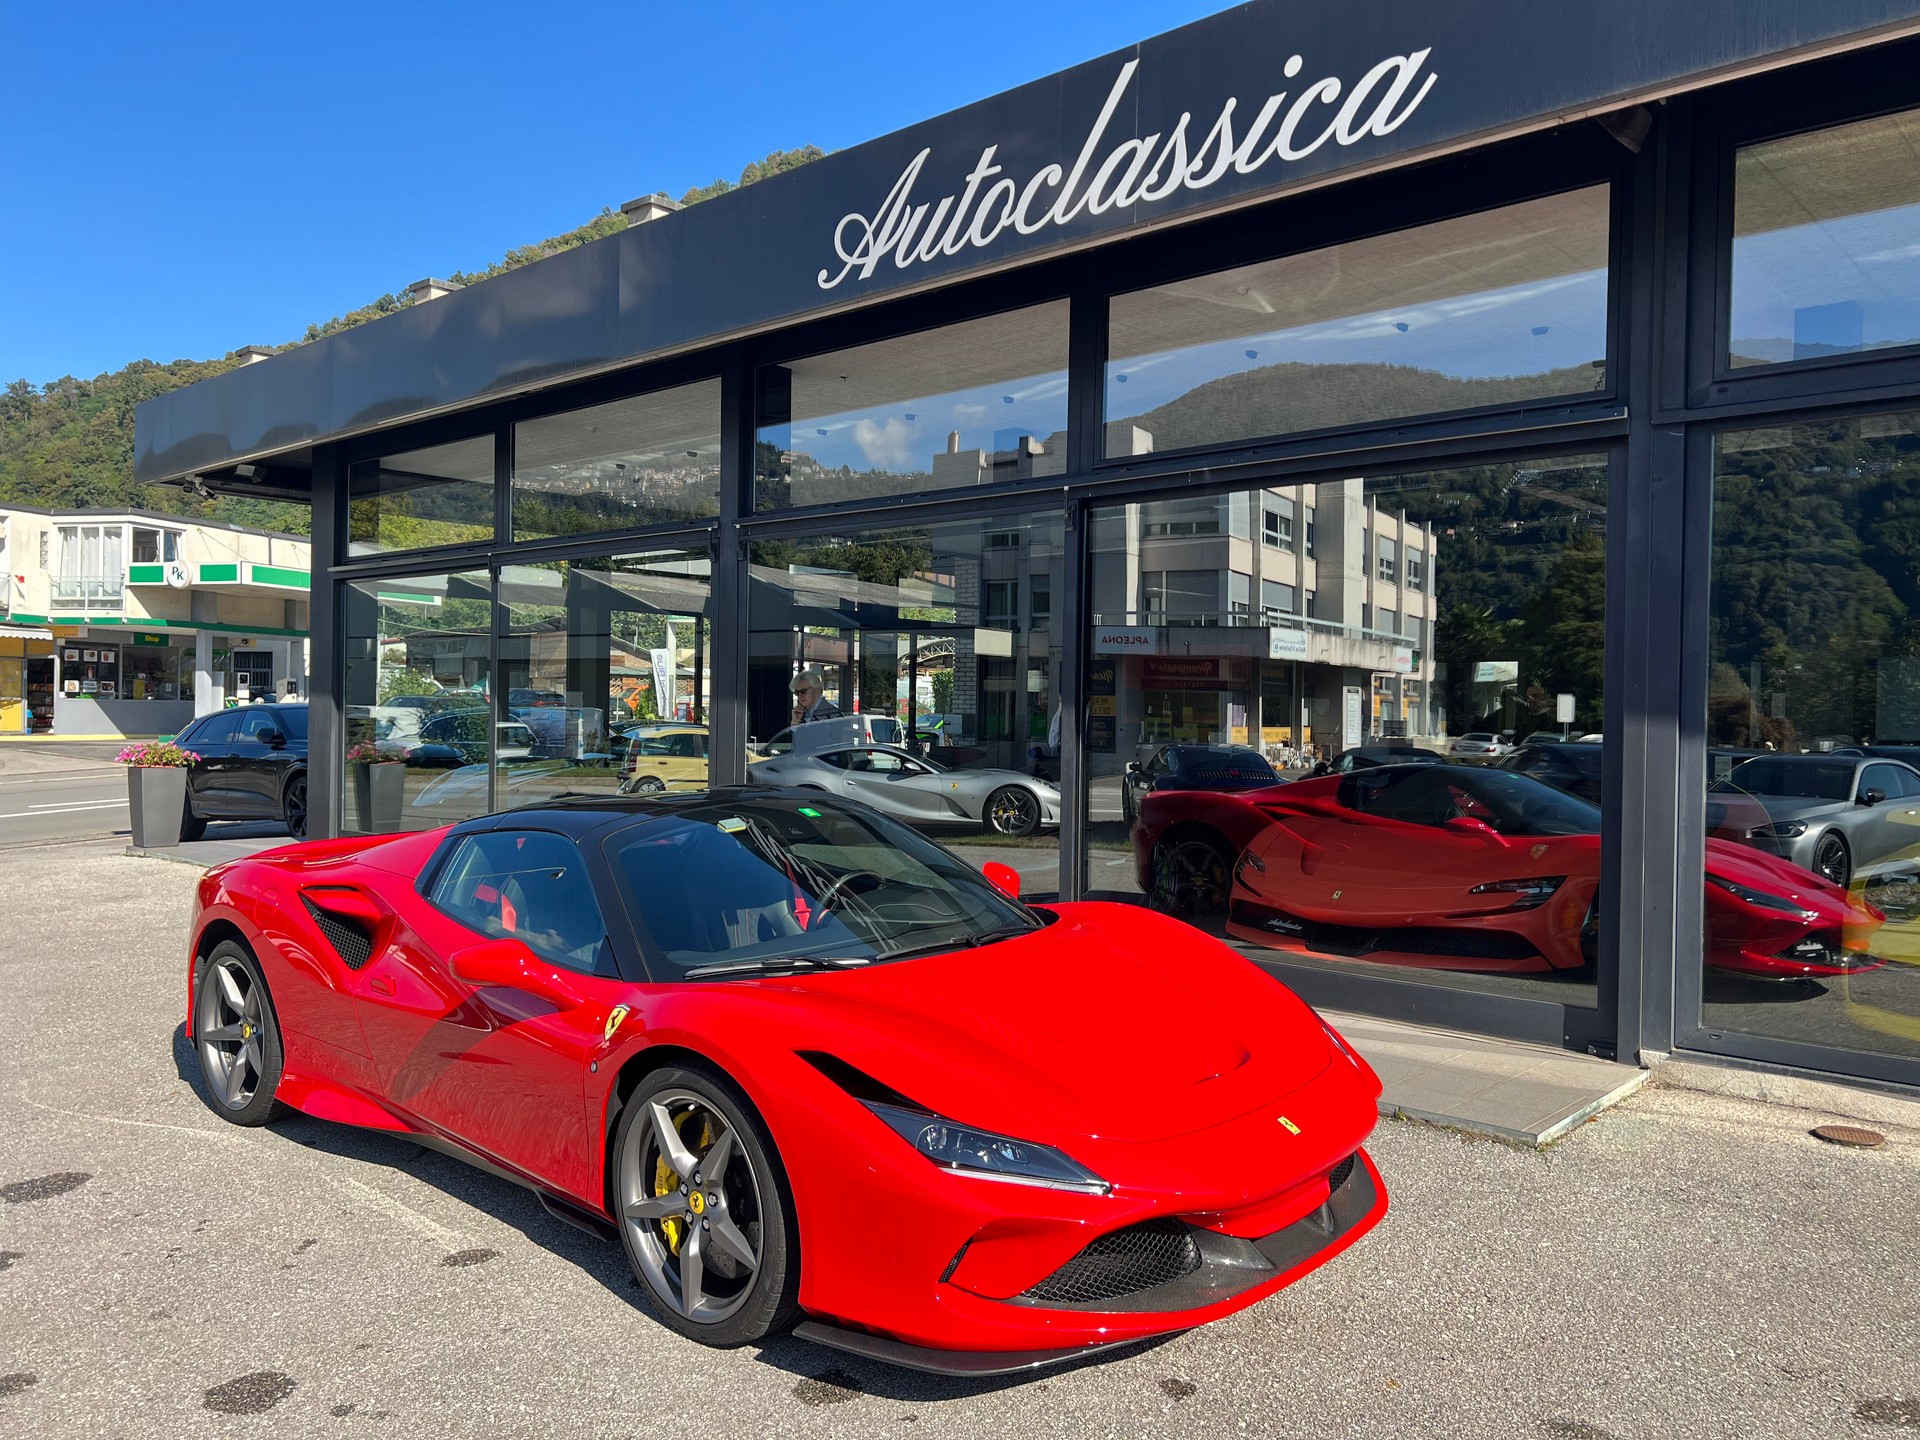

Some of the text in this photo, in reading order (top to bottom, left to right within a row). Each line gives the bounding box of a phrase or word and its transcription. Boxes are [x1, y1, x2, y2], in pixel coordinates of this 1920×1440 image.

[817, 46, 1438, 290] Autoclassica
[172, 566, 184, 580] PK
[145, 635, 160, 643] Shop
